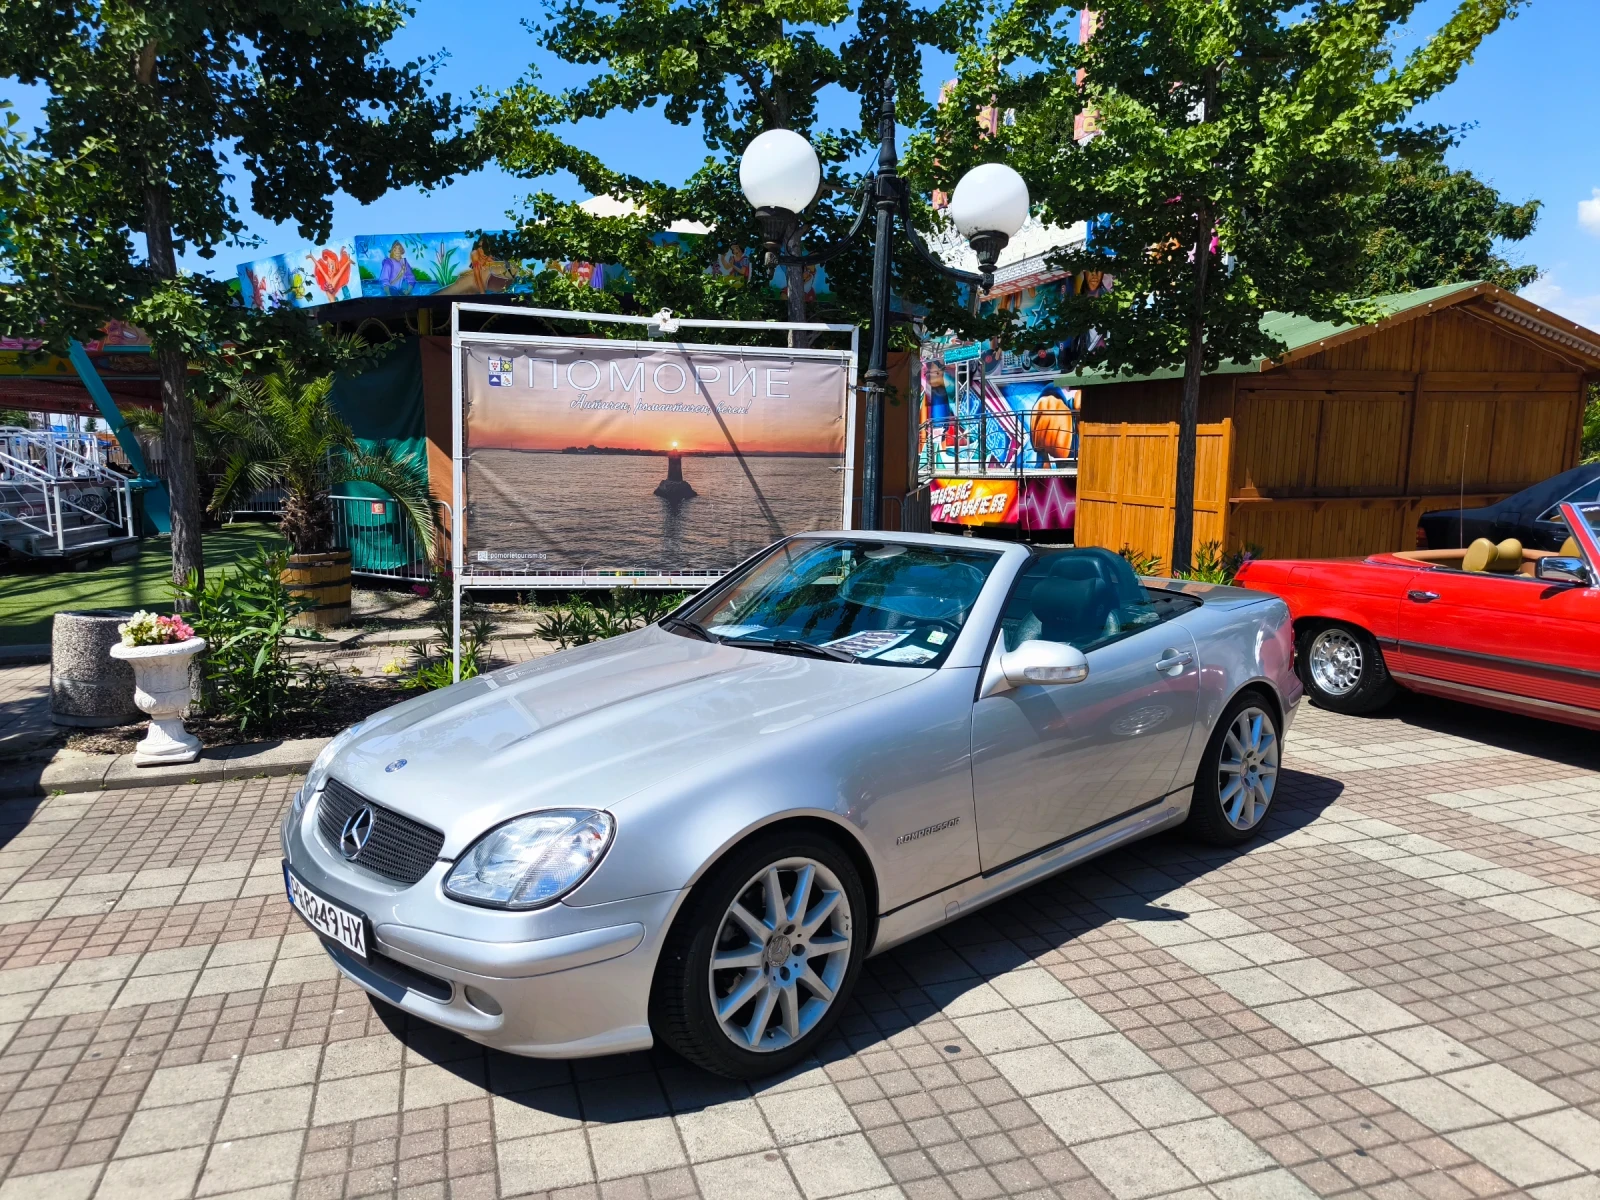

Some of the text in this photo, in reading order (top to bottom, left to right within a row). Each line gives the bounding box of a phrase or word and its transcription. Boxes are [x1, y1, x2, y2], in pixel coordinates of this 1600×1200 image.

[527, 357, 791, 399] ПОМОРИЕ
[570, 393, 631, 413] Античен,
[930, 479, 974, 506] MUSIC
[940, 493, 1008, 520] POWER
